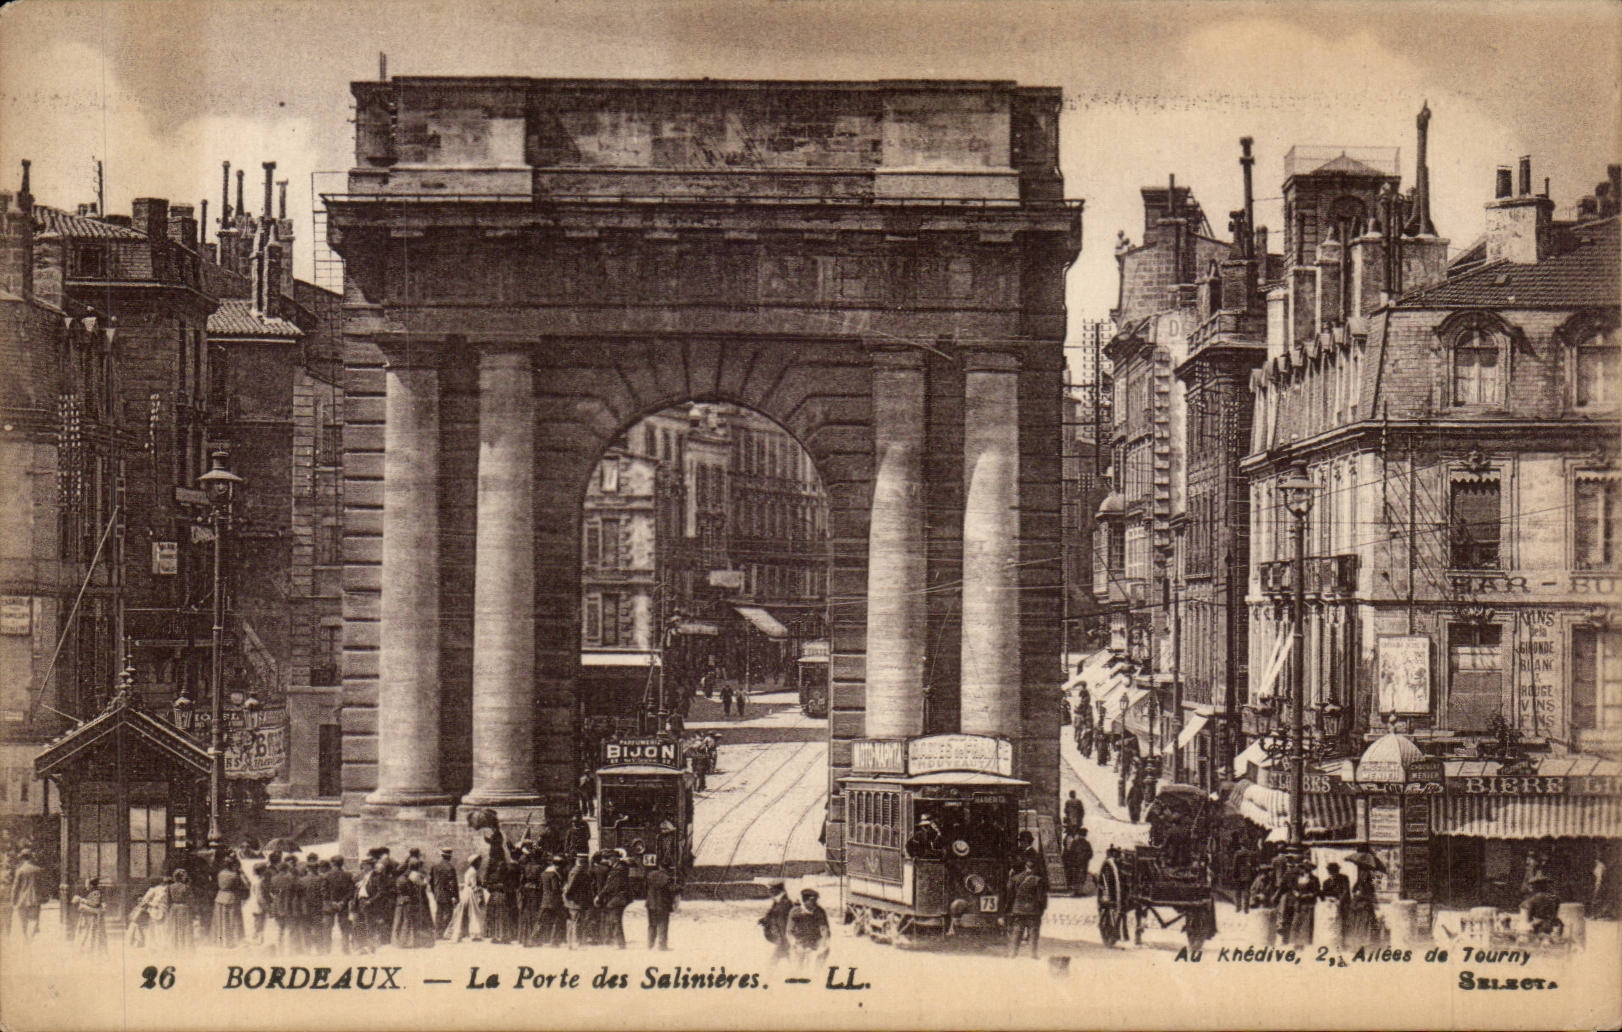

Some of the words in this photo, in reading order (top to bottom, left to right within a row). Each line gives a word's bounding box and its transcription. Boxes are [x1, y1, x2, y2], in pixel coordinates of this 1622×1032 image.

[1520, 610, 1555, 627] VINS
[1521, 699, 1555, 712] VNS
[606, 744, 675, 759] BIJON
[1466, 777, 1564, 794] BIERE
[982, 897, 996, 910] 73
